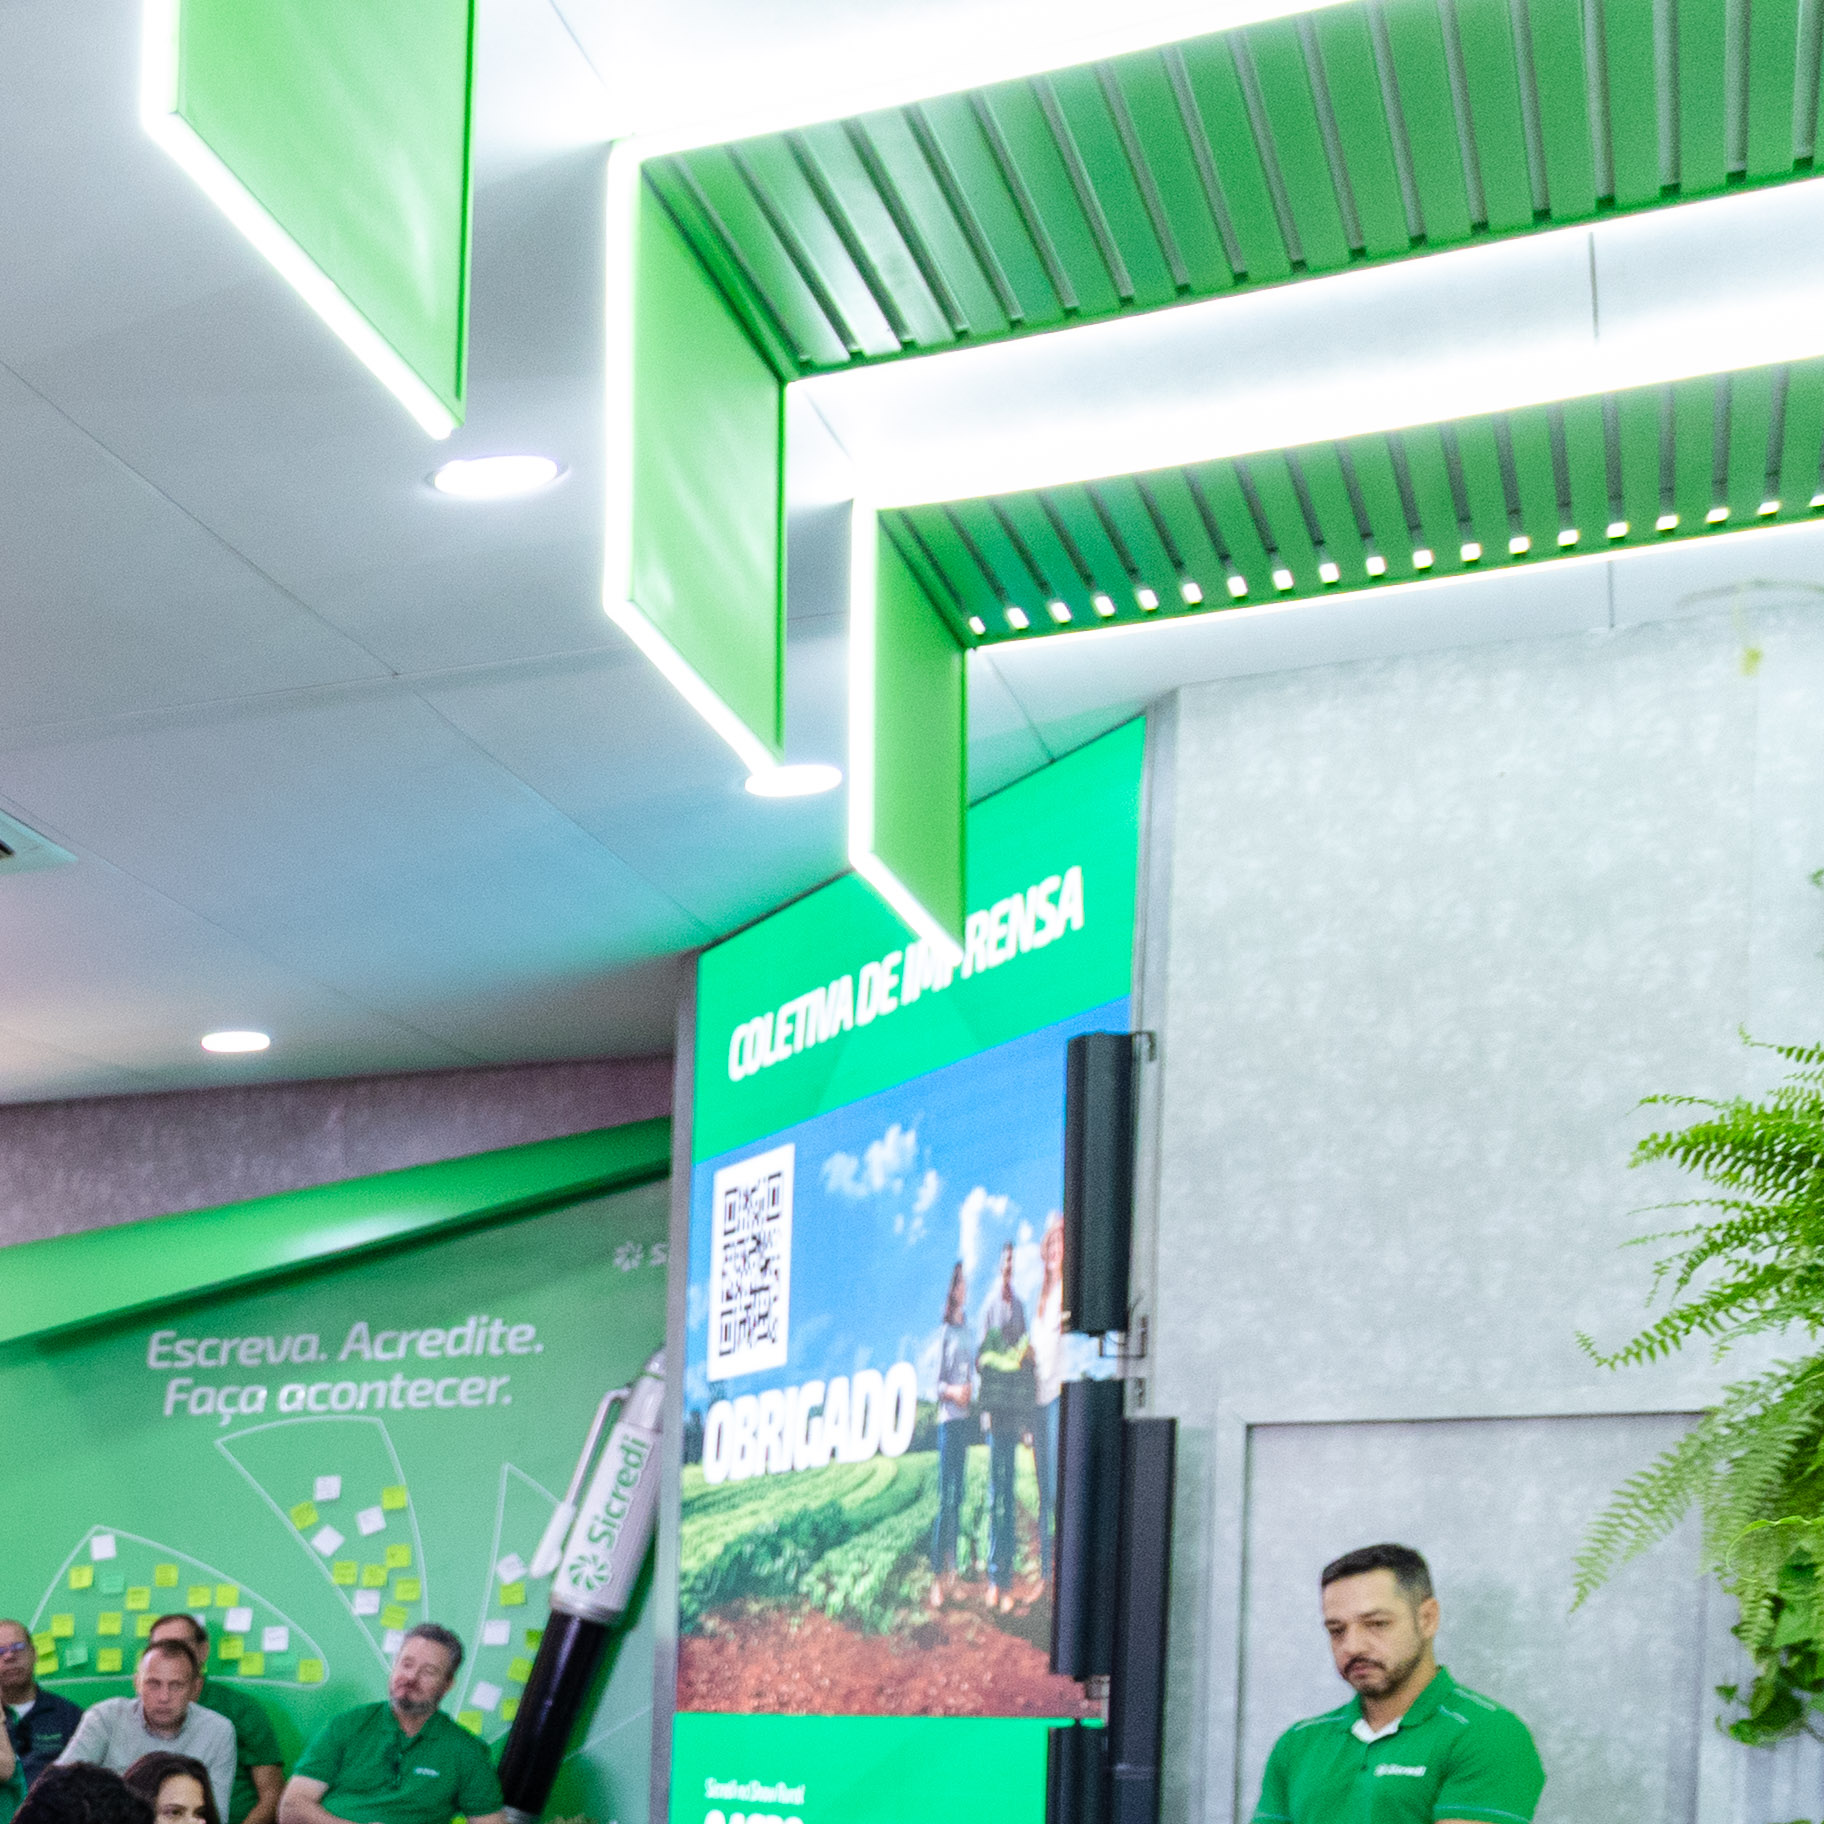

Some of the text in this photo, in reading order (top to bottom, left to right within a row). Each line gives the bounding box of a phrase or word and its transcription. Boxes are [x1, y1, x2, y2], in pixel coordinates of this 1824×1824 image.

[728, 974, 854, 1081] COLETIVA
[855, 950, 903, 1026] DE
[146, 1315, 544, 1369] Escreva. Acredite.
[163, 1372, 513, 1427] Faça acontecer.
[703, 1361, 917, 1485] OBRIGADO
[588, 1434, 649, 1549] Sicredi
